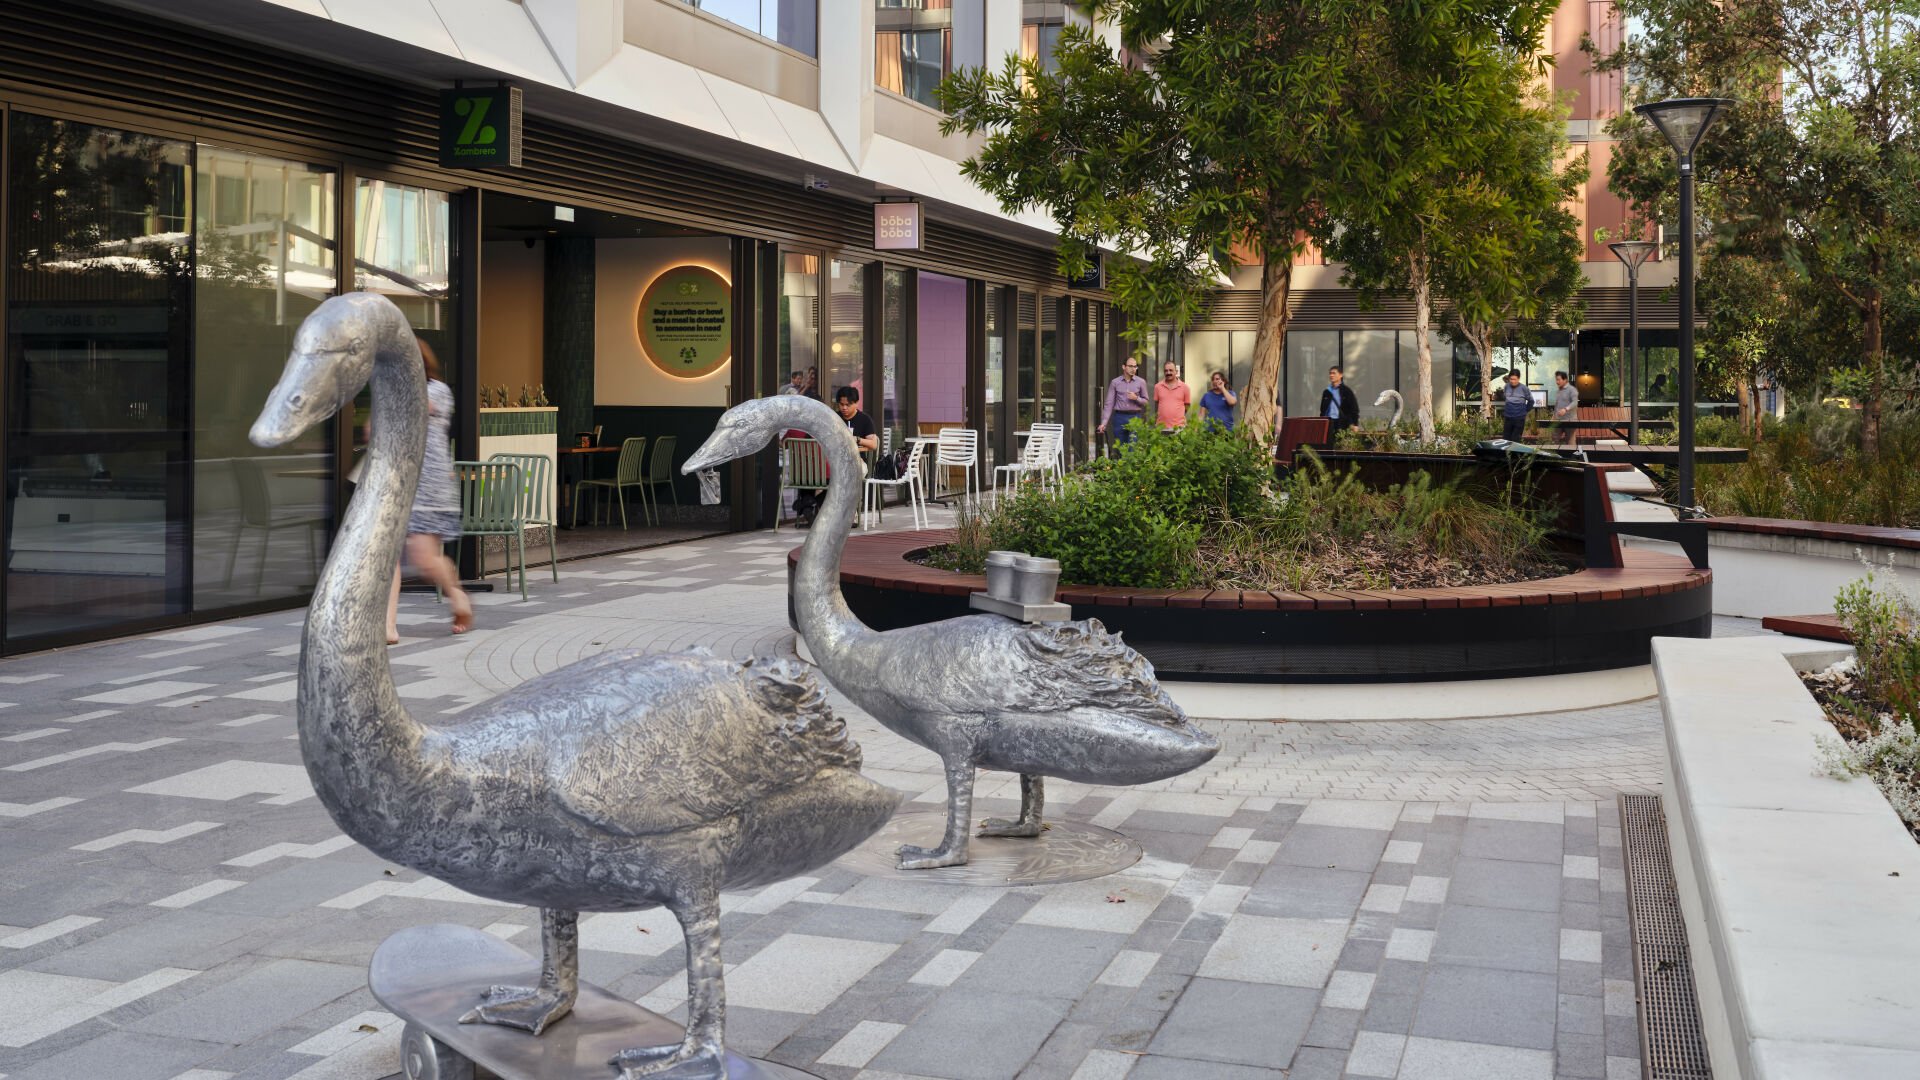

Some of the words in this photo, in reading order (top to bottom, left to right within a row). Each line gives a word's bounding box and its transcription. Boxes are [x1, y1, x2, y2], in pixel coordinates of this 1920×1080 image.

[454, 147, 497, 156] Zambrero
[654, 308, 667, 316] Buy
[46, 314, 81, 327] GRAB
[99, 314, 117, 327] GO
[652, 316, 666, 324] and
[696, 316, 725, 324] donated
[696, 324, 703, 332] in
[704, 324, 722, 332] need
